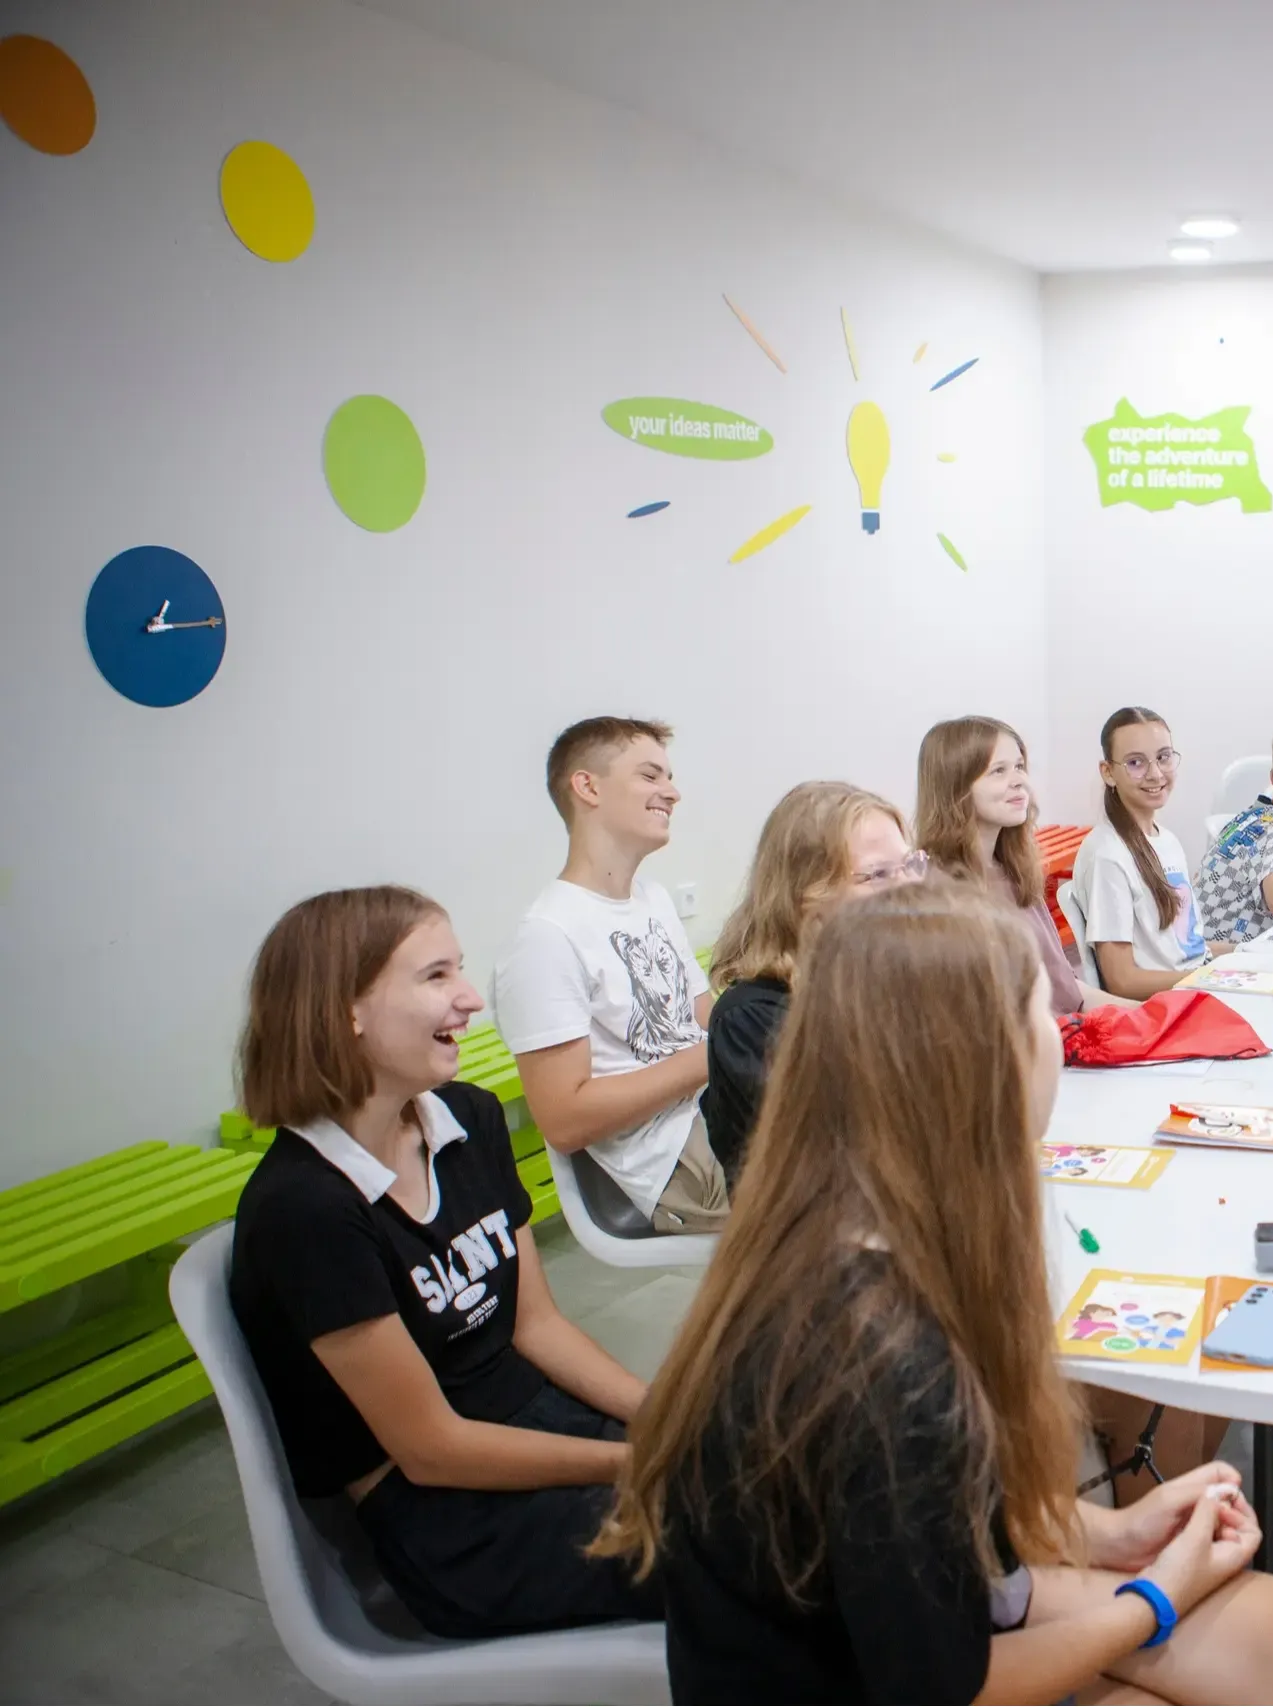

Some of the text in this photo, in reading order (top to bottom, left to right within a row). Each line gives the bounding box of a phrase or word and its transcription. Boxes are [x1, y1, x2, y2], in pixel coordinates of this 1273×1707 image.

[628, 413, 760, 441] your ideas matter
[1108, 423, 1221, 447] experience
[1108, 446, 1249, 466] the adventure
[1108, 468, 1224, 489] of a lifetime
